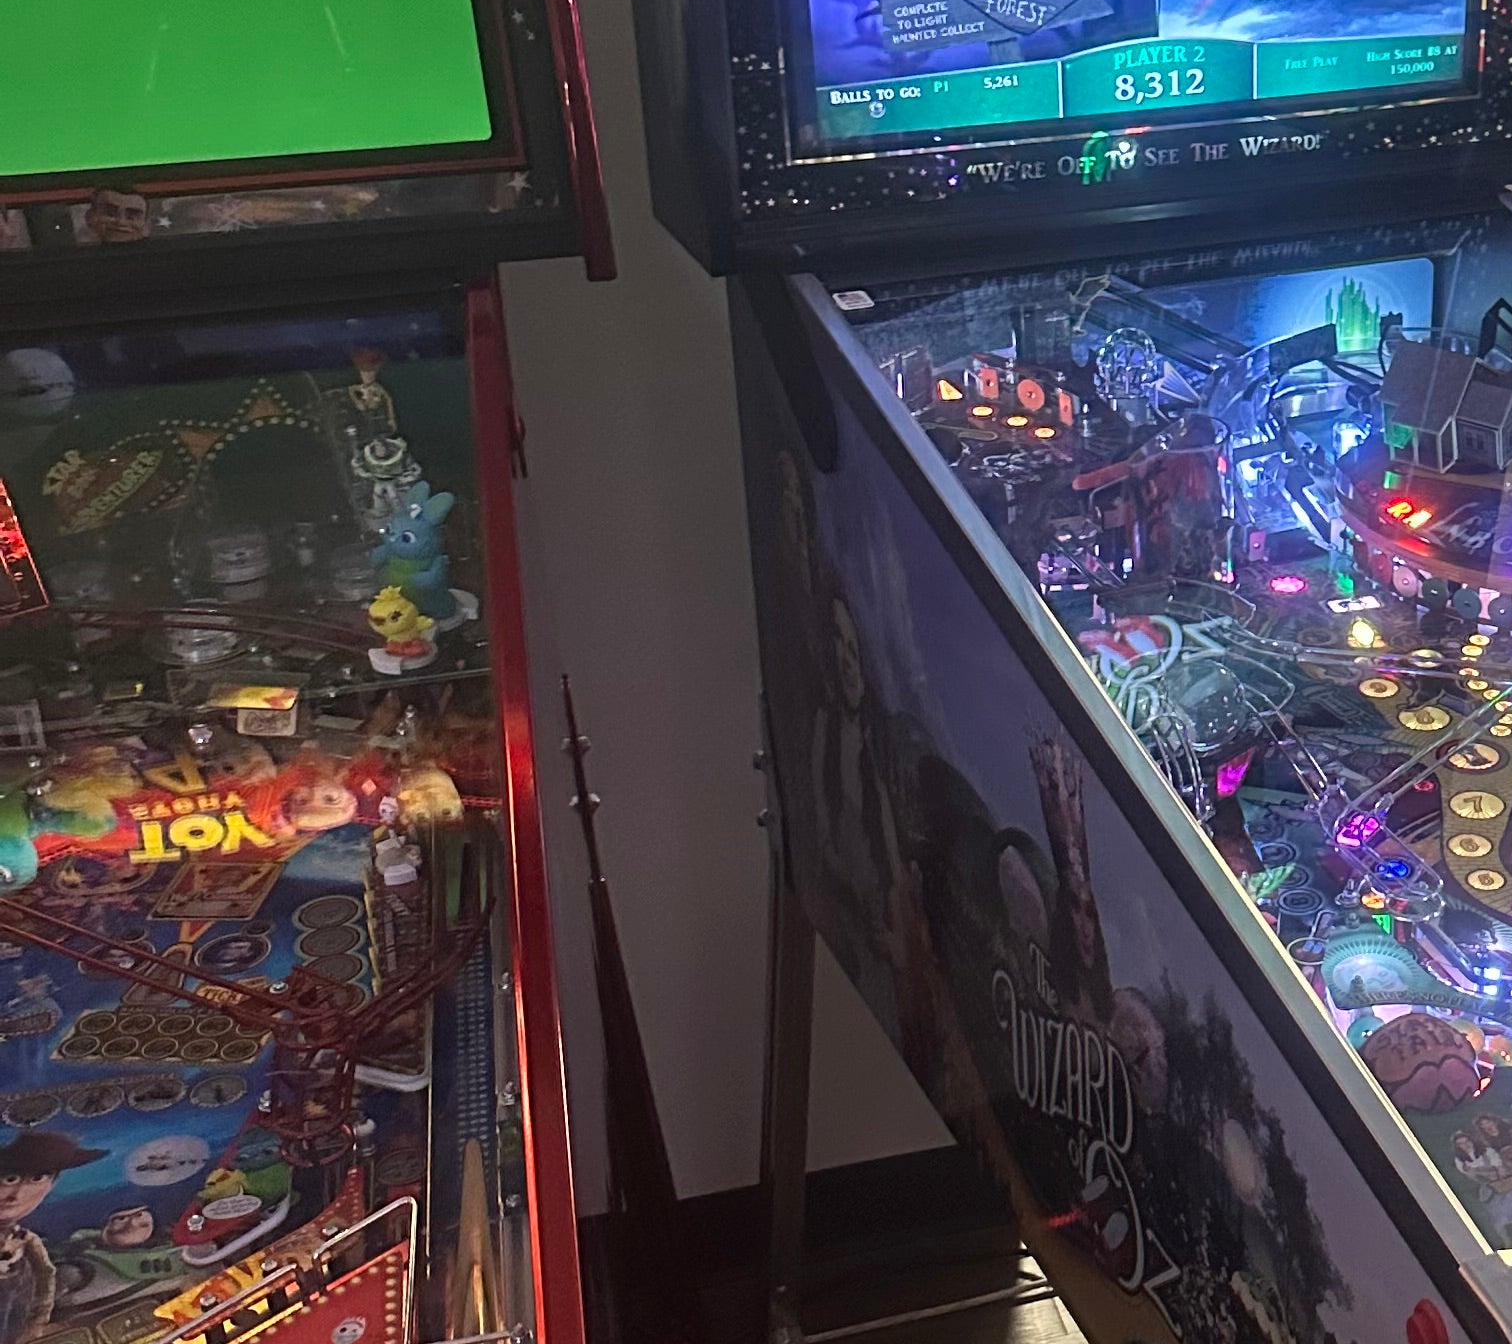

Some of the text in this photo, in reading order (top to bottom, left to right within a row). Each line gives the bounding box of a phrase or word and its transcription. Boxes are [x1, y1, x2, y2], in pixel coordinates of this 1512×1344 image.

[894, 0, 949, 18] COMPLETE
[897, 13, 949, 30] TO LIGHT
[1113, 45, 1206, 71] PLAYER 2
[1389, 60, 1436, 76] 150,000
[933, 79, 949, 93] P1
[983, 74, 1020, 90] 5,261
[1114, 67, 1206, 105] 8,312
[830, 88, 872, 106] BALLS
[876, 87, 895, 102] TO
[1144, 145, 1181, 168] SEE
[1190, 141, 1230, 163] THE
[1463, 794, 1483, 813] 7
[991, 968, 1134, 1155] WIZARD
